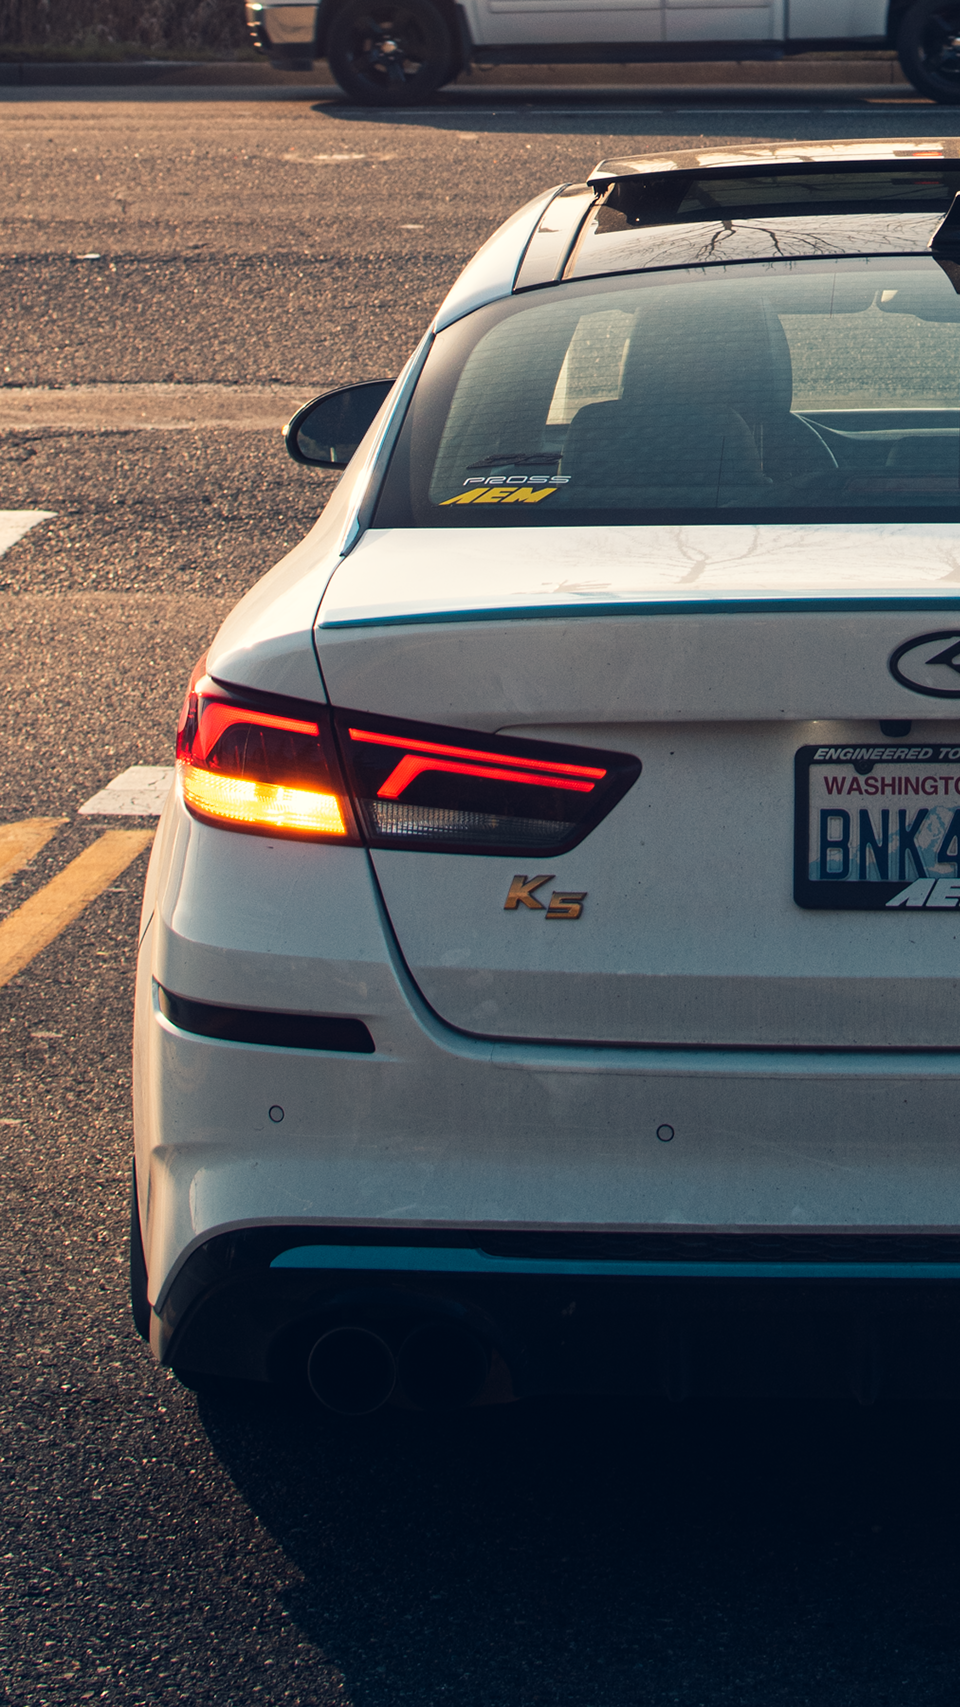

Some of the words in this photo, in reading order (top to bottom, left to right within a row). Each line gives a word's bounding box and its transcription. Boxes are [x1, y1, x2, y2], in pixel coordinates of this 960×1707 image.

[438, 487, 558, 506] AEM
[813, 748, 933, 761] ENGINEERED
[503, 874, 588, 920] K5
